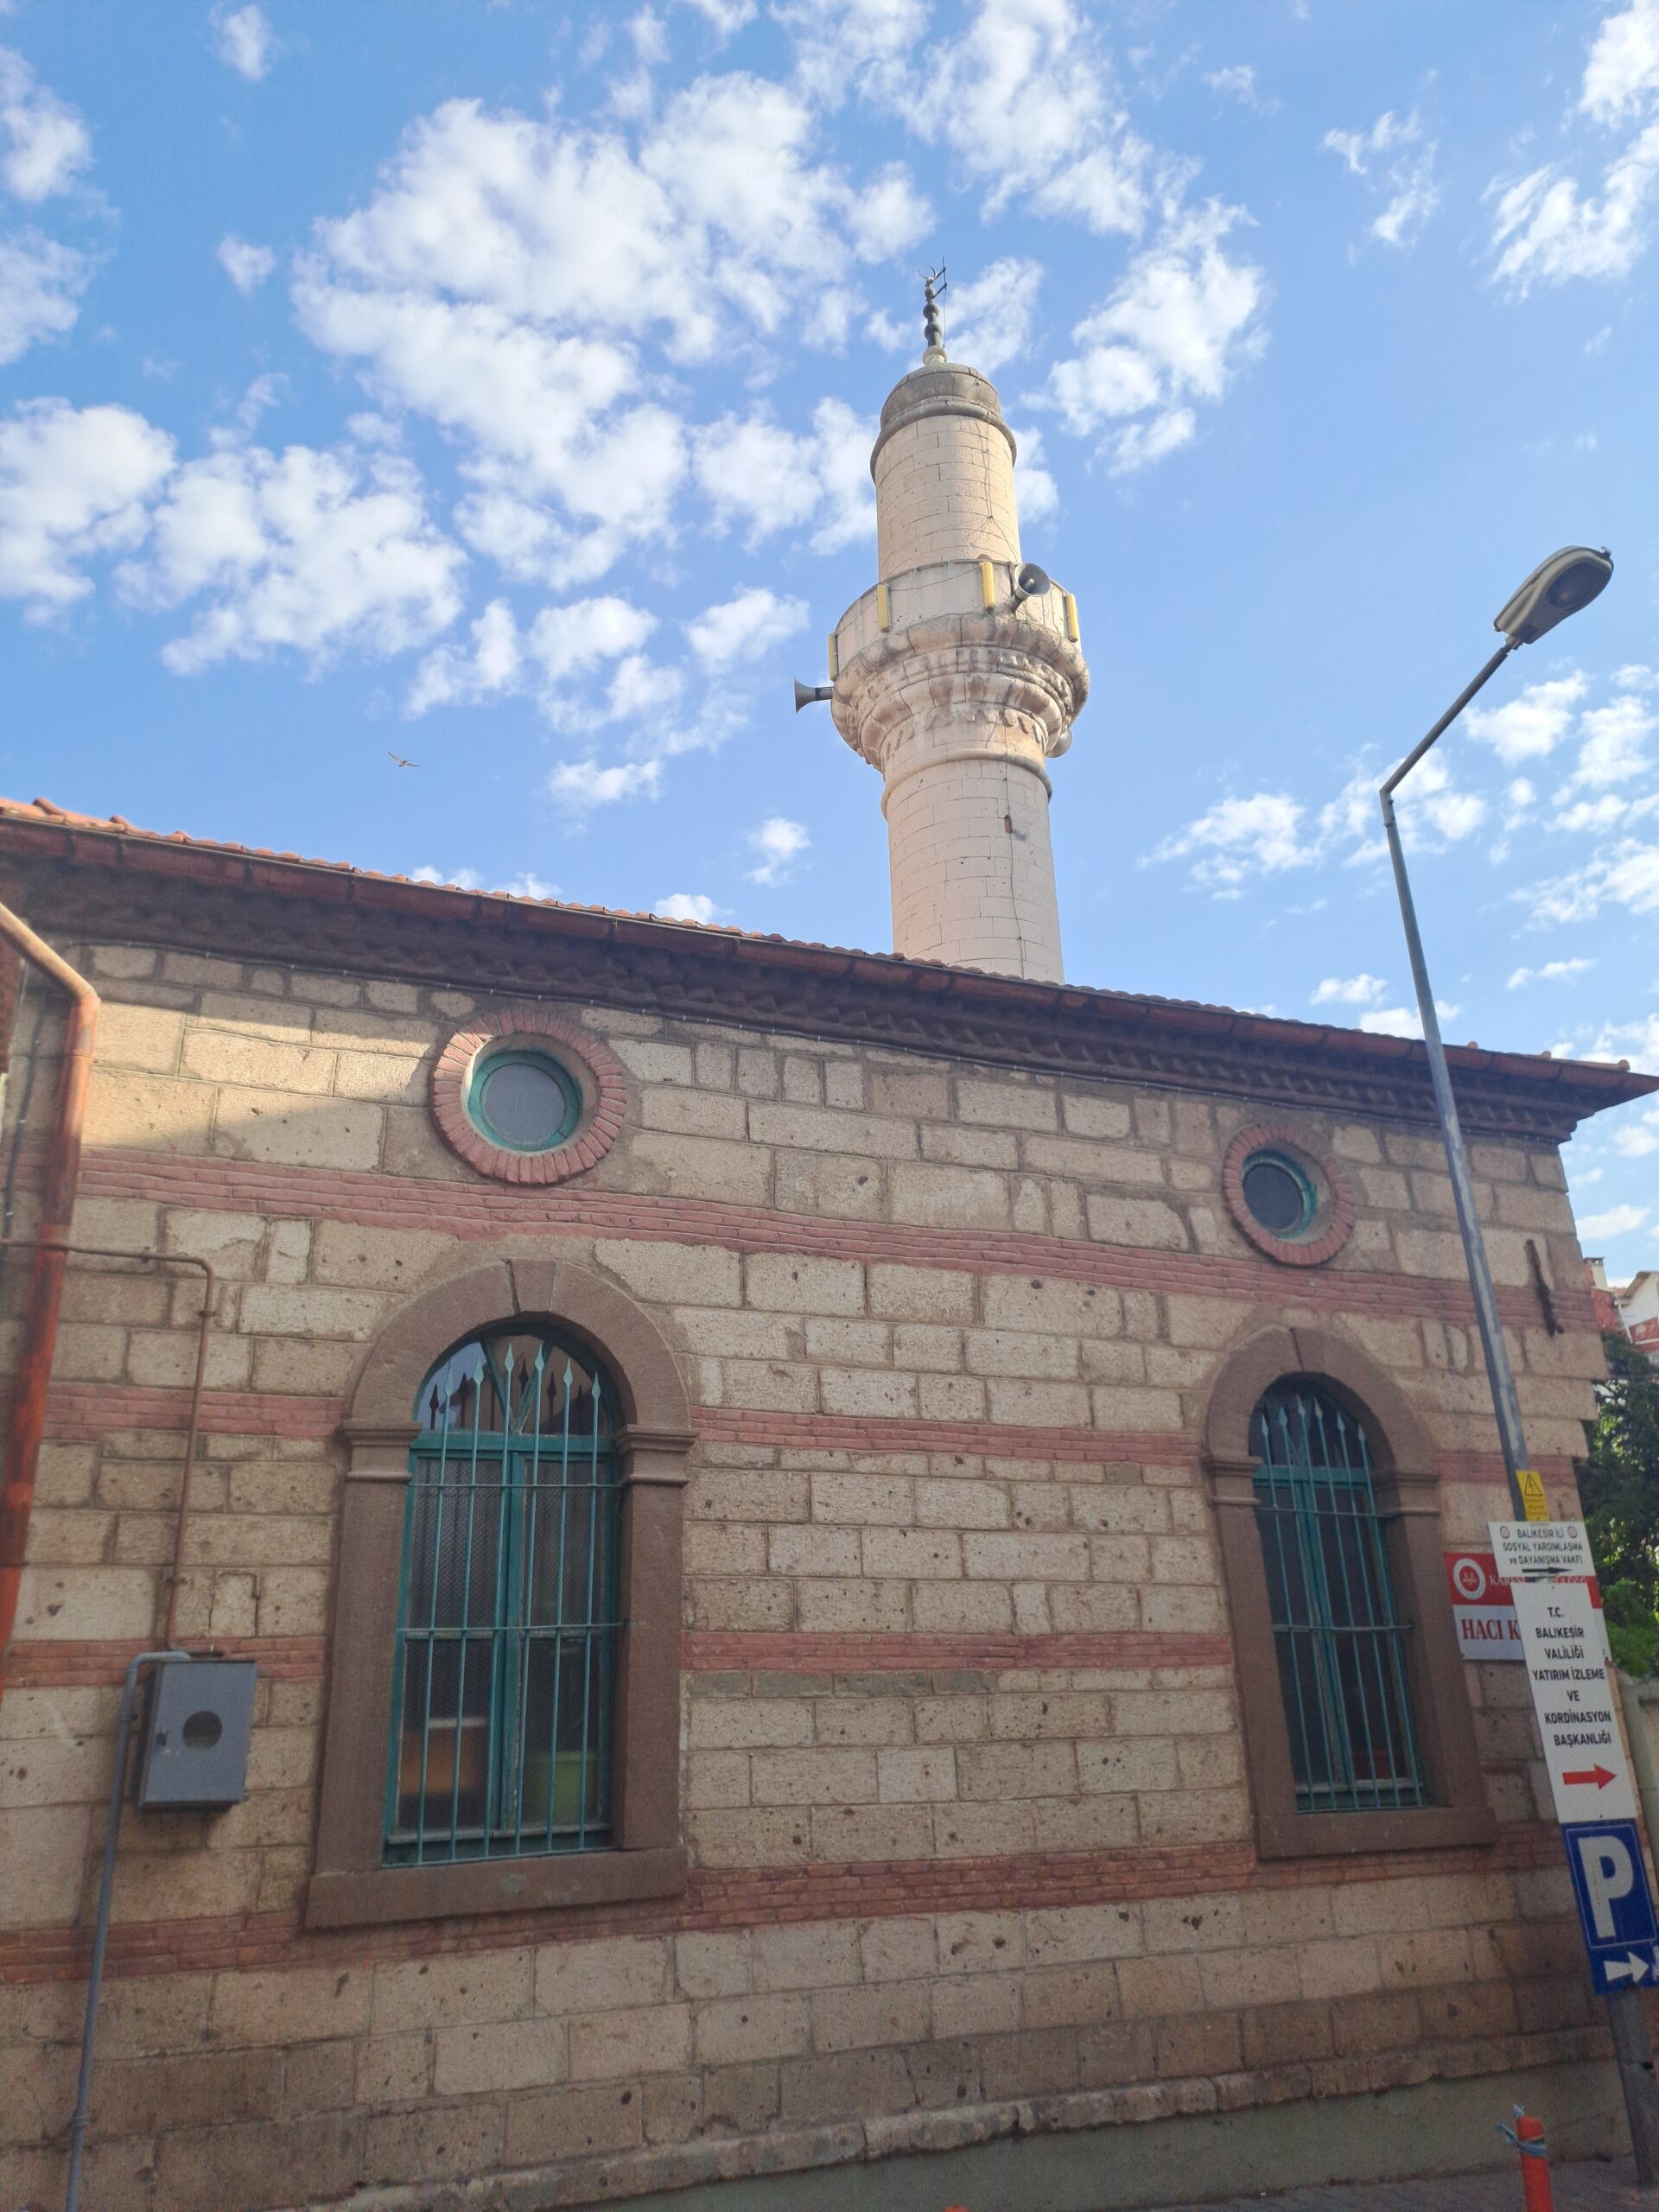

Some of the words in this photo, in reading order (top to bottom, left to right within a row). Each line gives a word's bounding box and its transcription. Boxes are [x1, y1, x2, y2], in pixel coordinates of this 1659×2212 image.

[1503, 1542, 1531, 1552] SOSYAL
[1534, 1542, 1583, 1553] YARDIMLAŞMA
[1518, 1555, 1560, 1566] DAYANIŞMA
[1548, 1607, 1564, 1618] T.C.
[1460, 1618, 1504, 1640] HACI
[1535, 1624, 1585, 1638] BALIKESİR
[1544, 1645, 1585, 1659] VALİLİĞİ
[1532, 1669, 1569, 1681] YATIRIM
[1571, 1666, 1605, 1680] İZLEME
[1566, 1690, 1580, 1701] VE
[1544, 1709, 1611, 1724] KORDİNASYON
[1554, 1729, 1611, 1747] BAŞKANLIĞI
[1577, 1835, 1634, 1938] P
